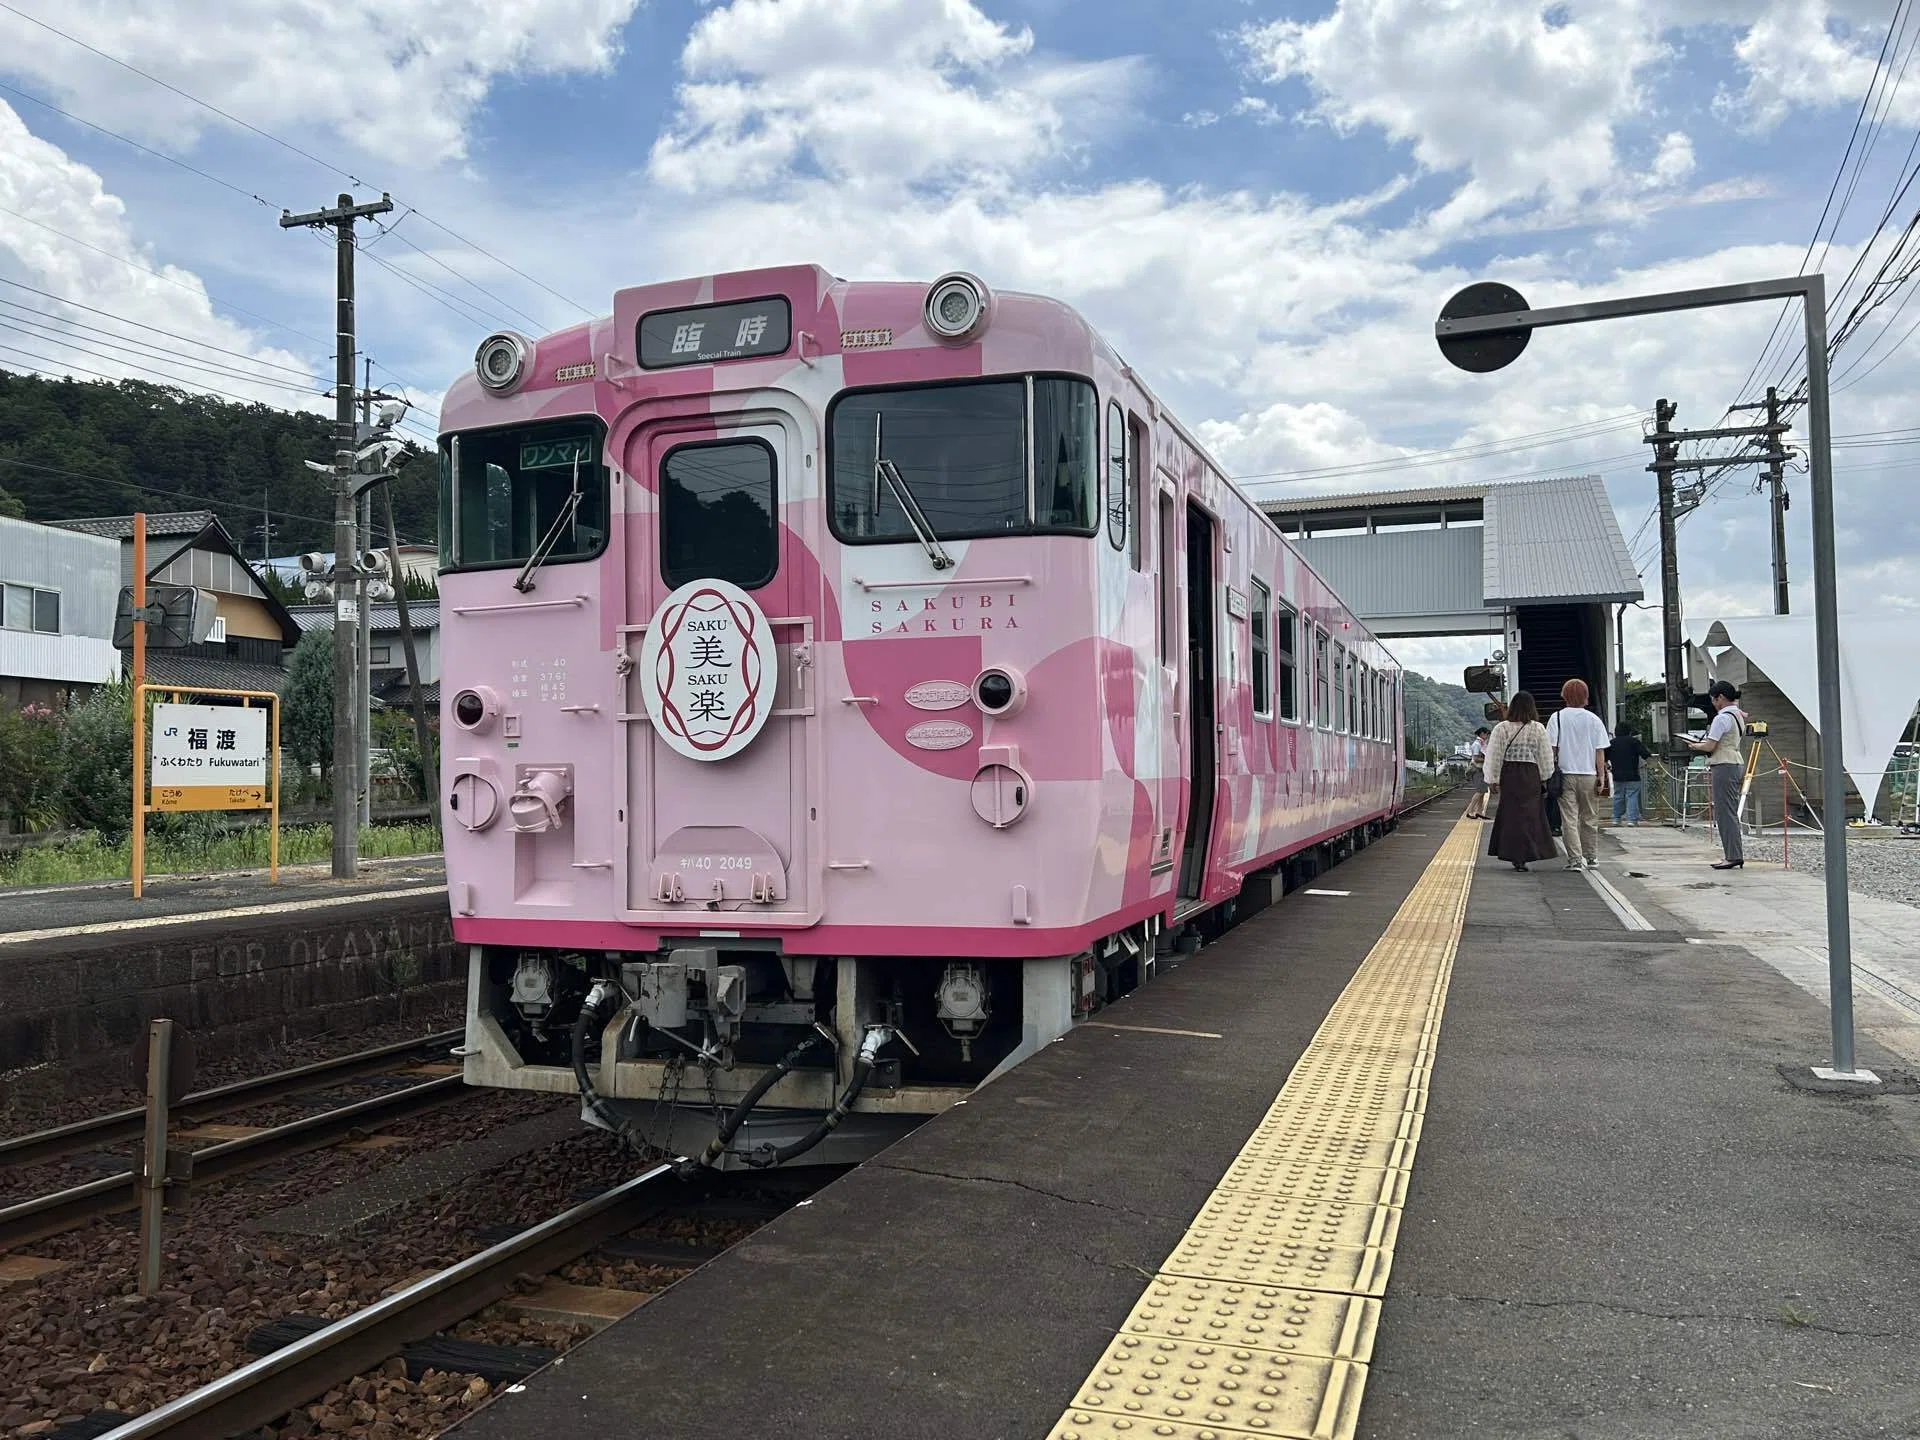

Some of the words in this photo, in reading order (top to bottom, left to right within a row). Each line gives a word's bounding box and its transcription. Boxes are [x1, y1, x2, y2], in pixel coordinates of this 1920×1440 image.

[671, 314, 768, 354] 臨時
[697, 351, 722, 360] Special
[724, 350, 742, 358] Train
[524, 440, 589, 466] ワンマン
[871, 594, 1016, 612] SAKUBI
[687, 619, 727, 632] SAKU
[871, 616, 1019, 634] SAKURA
[1510, 630, 1516, 642] 1
[685, 635, 733, 669] 美
[687, 674, 728, 686] SAKU
[686, 689, 732, 722] 楽
[164, 727, 178, 737] JR
[188, 728, 236, 750] 福渡
[160, 757, 203, 767] ふくわたり
[209, 757, 260, 767] Fukuwatari
[680, 857, 712, 870] キハ40
[720, 857, 752, 870] 2049
[190, 941, 267, 987] FOR
